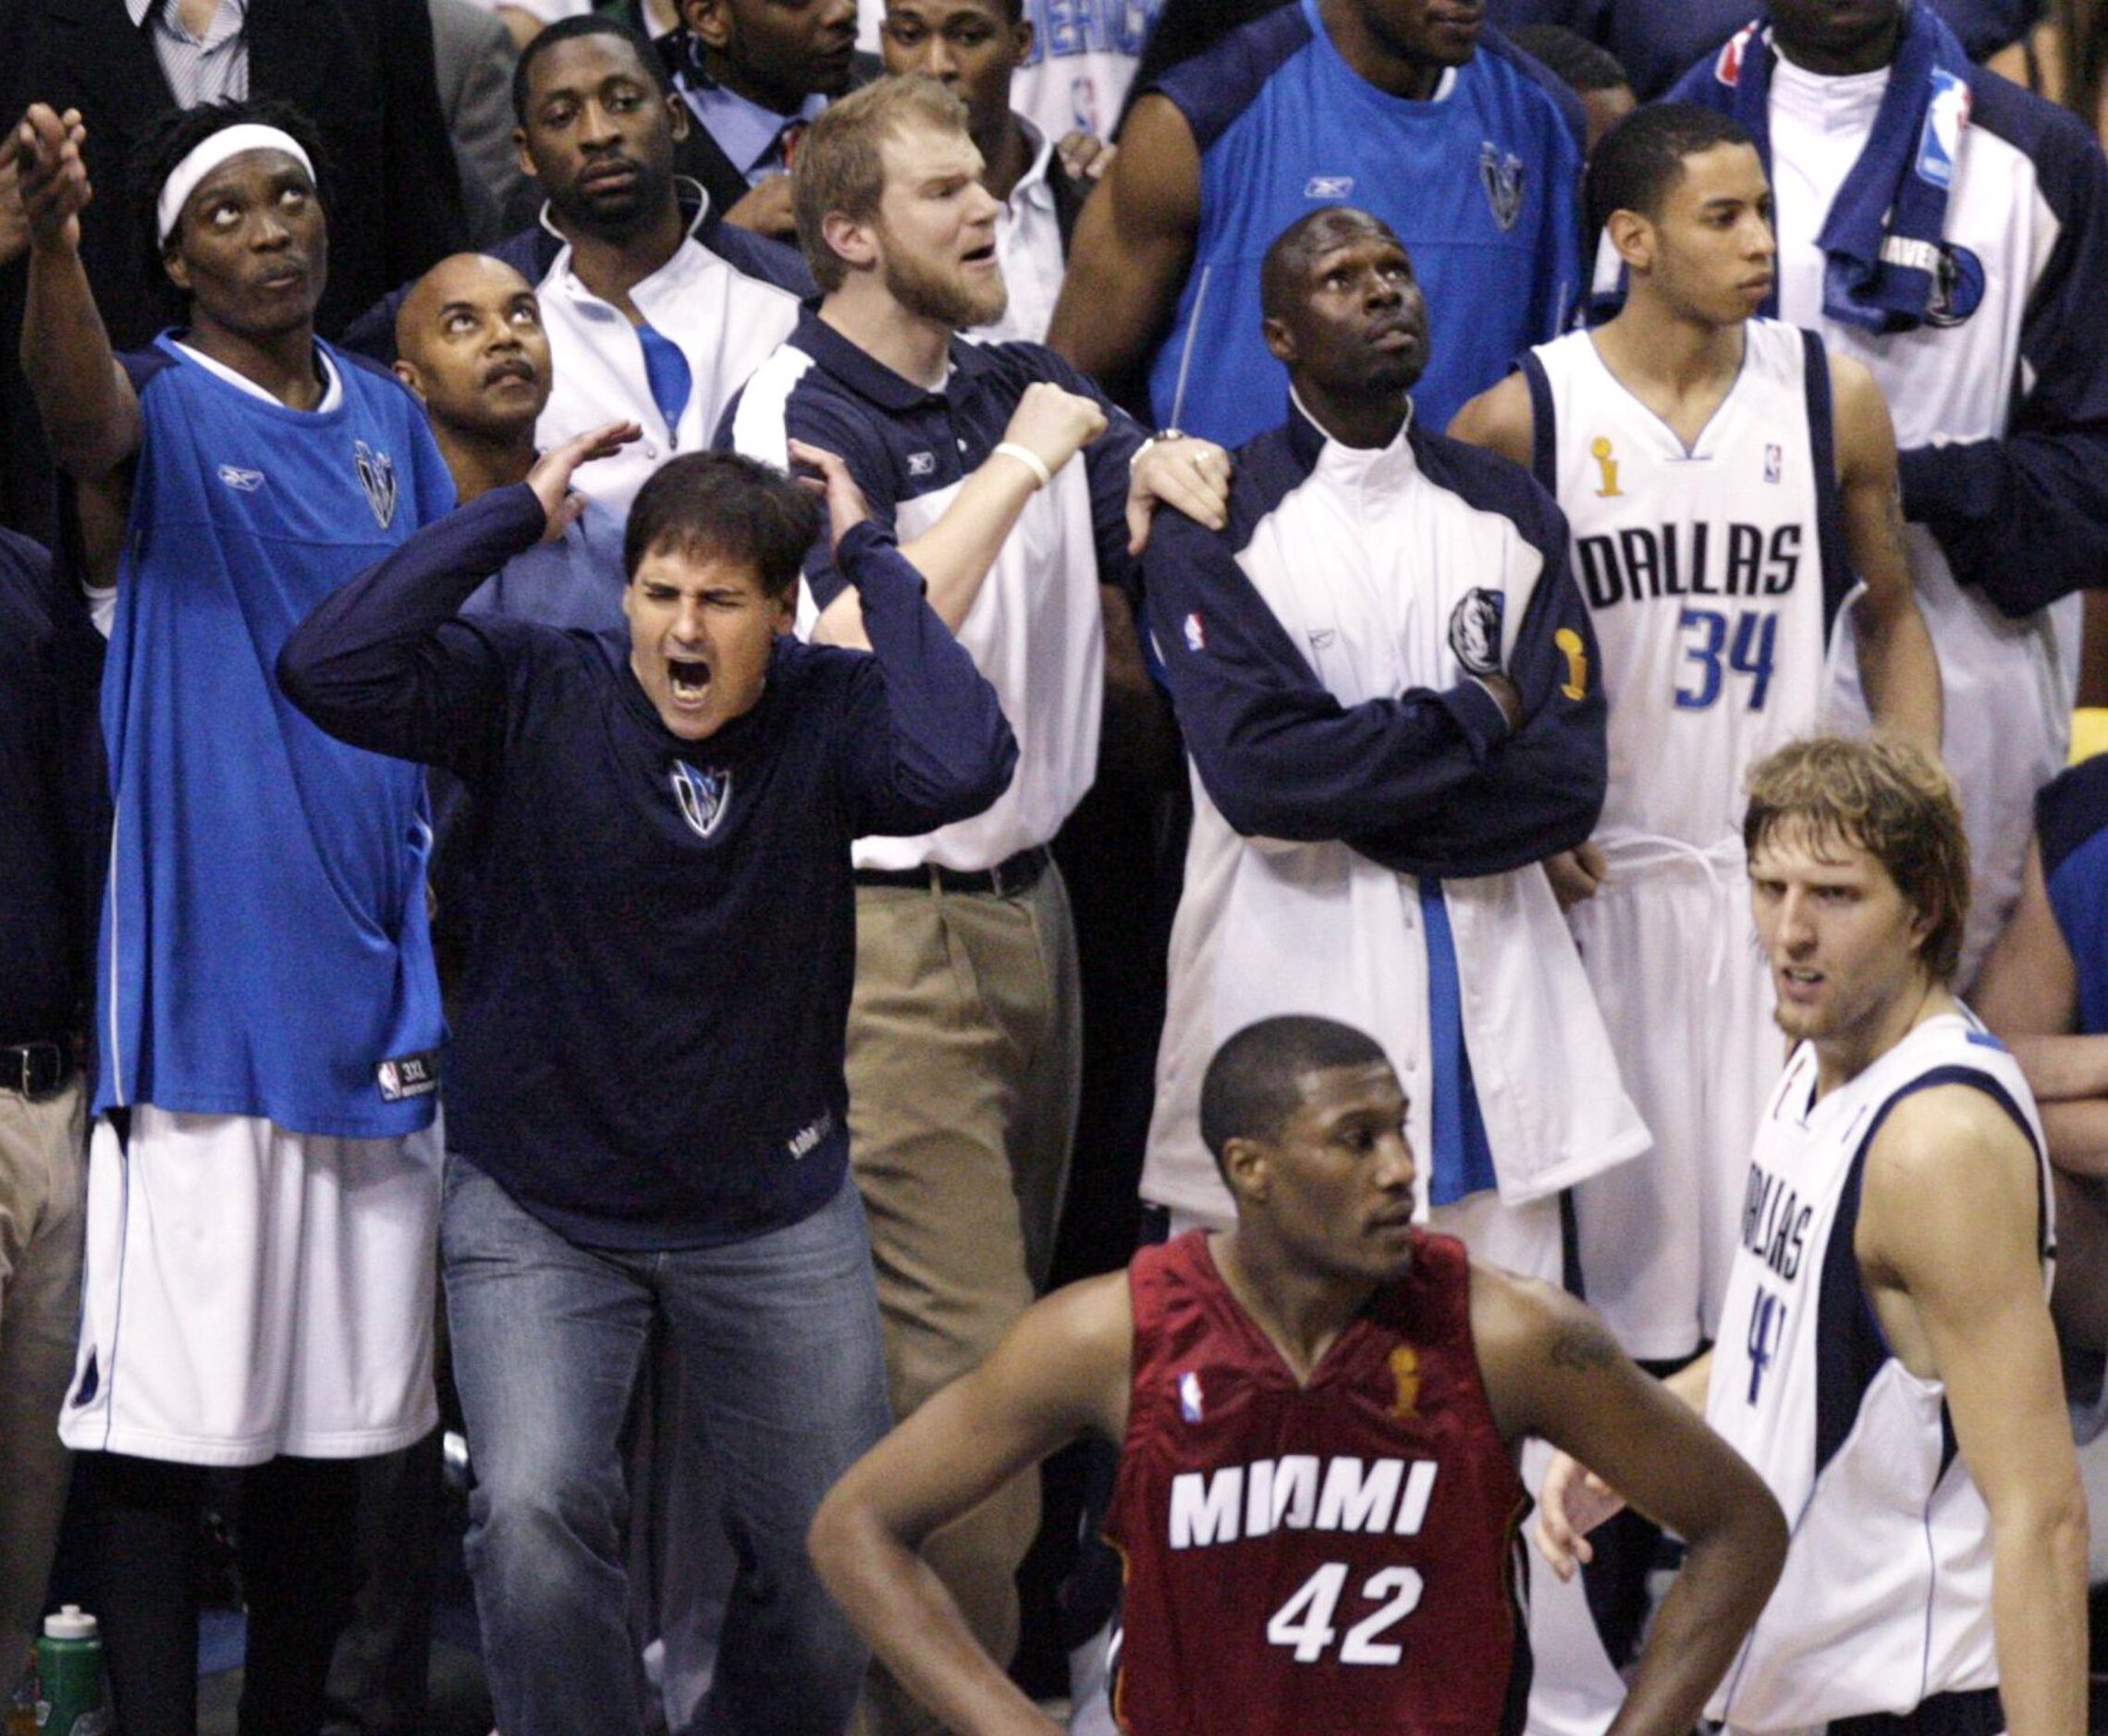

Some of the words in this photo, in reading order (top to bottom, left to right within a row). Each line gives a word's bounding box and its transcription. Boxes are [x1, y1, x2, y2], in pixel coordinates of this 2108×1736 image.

[1575, 521, 1802, 610] DALLAS
[1674, 606, 1778, 712] 34
[1169, 1454, 1439, 1550] MIAMI
[1266, 1560, 1425, 1666] 42
